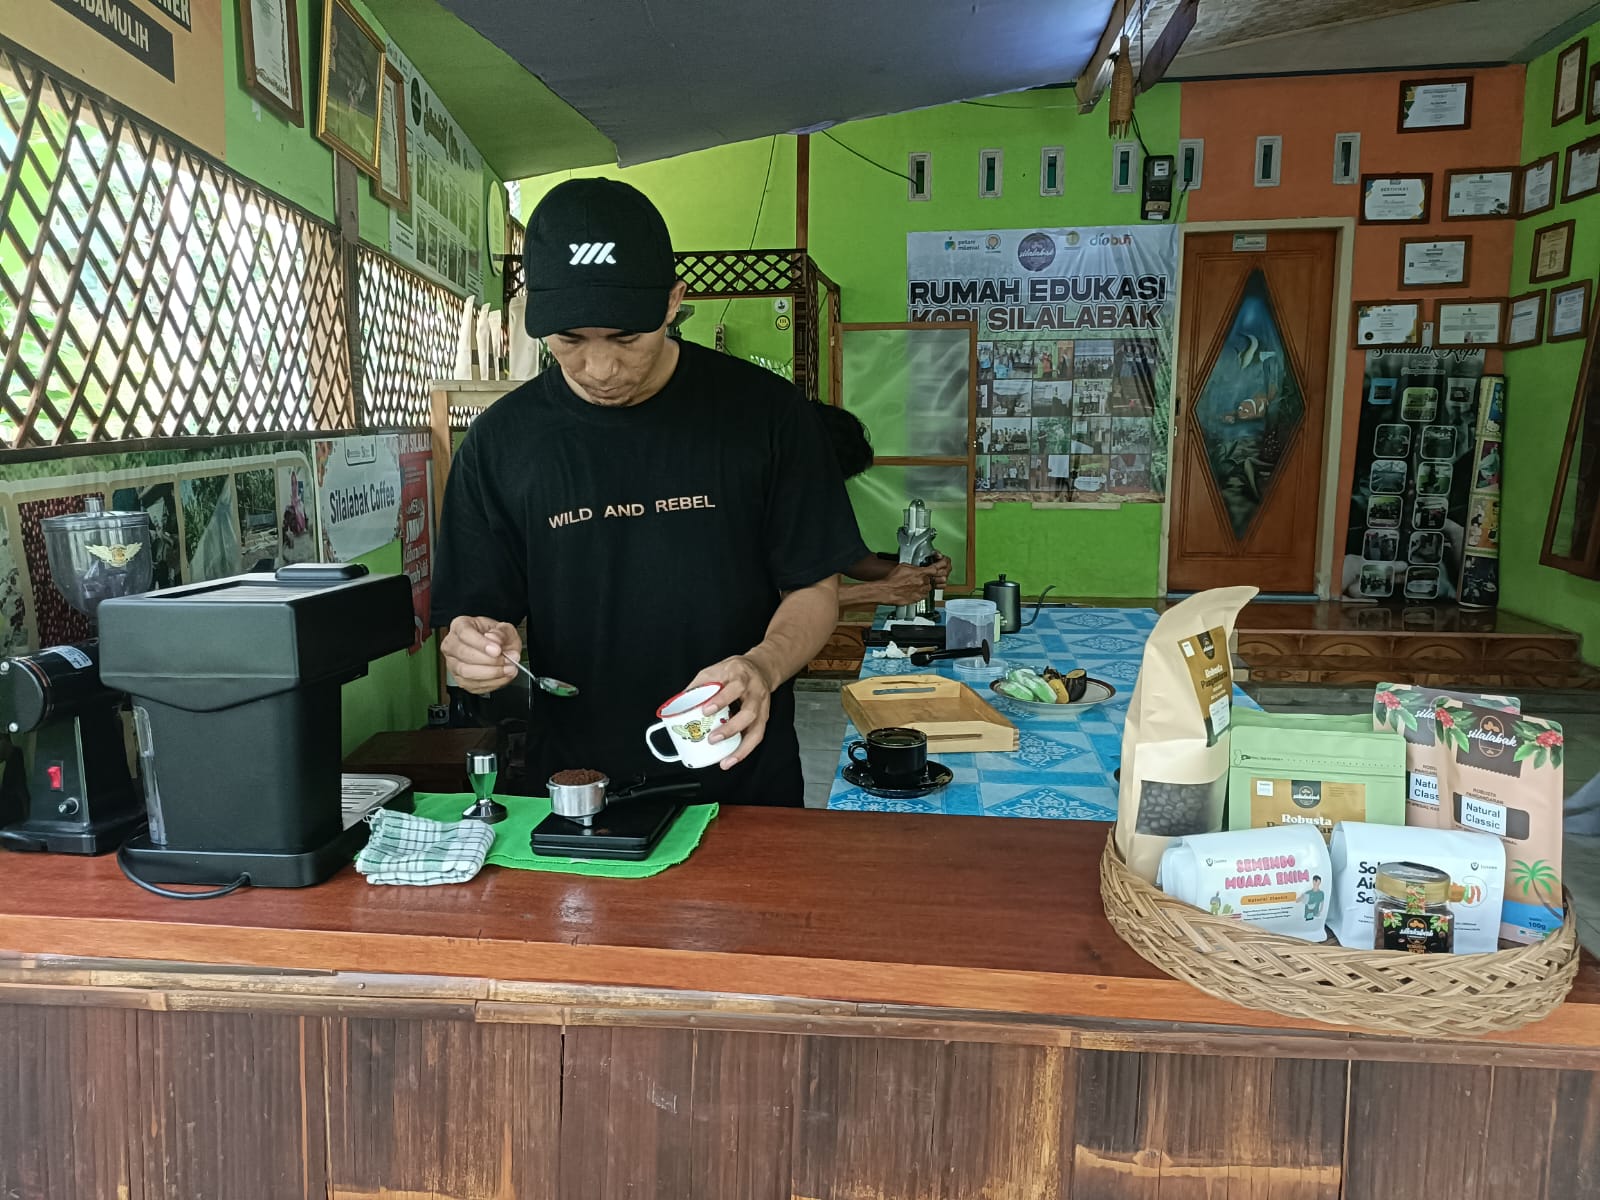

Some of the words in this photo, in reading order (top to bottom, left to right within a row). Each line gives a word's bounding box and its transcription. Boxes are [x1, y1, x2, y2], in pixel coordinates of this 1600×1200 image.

[909, 278, 1021, 305] RUMAH
[1029, 275, 1167, 302] EDUKASI
[988, 304, 1163, 330] SILALABAK
[329, 486, 370, 525] Silalabak
[369, 482, 395, 514] Coffee
[548, 507, 593, 529] WILD
[603, 503, 645, 518] AND
[655, 495, 716, 513] REBEL
[1467, 728, 1518, 747] silalabak
[1415, 777, 1437, 790] Natu
[1414, 788, 1440, 801] Class
[1466, 801, 1500, 818] Natural
[1281, 813, 1332, 826] Robusta
[1465, 813, 1500, 830] Classic
[1236, 854, 1296, 873] SEMENDO
[1358, 861, 1381, 874] So
[1224, 873, 1271, 890] MUARA
[1276, 869, 1310, 885] ENIM
[1528, 921, 1546, 930] 100g
